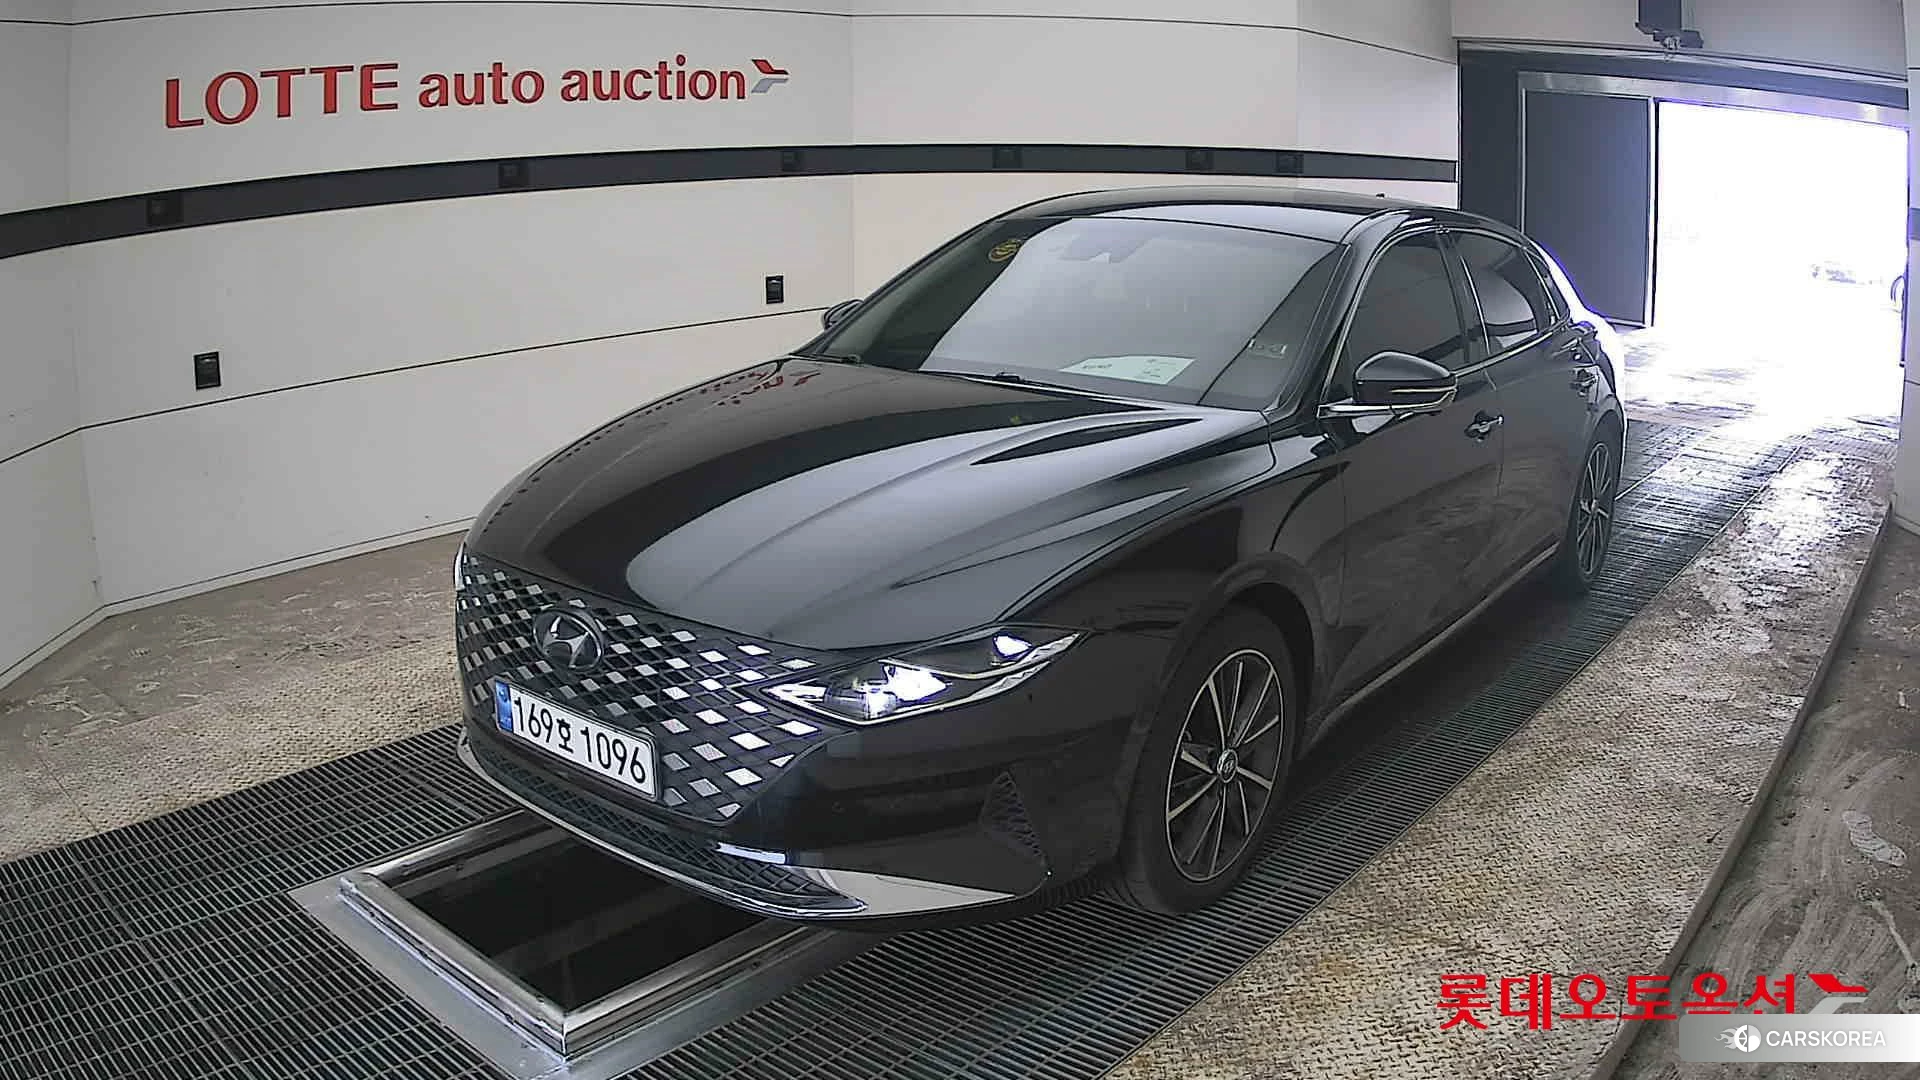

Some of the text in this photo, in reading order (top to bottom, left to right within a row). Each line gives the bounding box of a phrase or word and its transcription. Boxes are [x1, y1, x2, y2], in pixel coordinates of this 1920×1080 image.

[165, 54, 747, 128] LOTTE auto auction
[514, 696, 646, 784] 169호 1096
